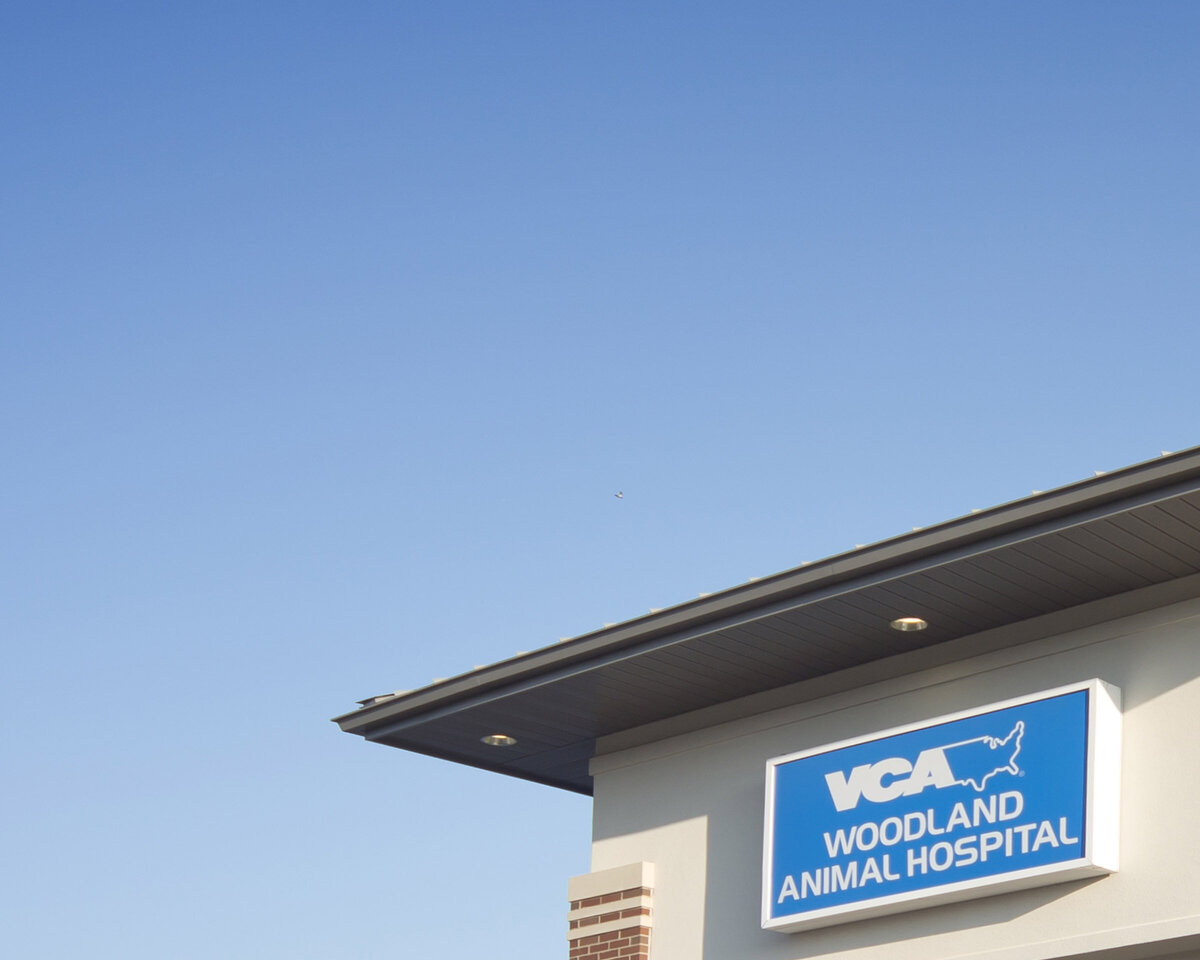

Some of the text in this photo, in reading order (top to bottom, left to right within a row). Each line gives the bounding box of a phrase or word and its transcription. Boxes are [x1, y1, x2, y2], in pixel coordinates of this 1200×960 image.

[824, 749, 957, 812] VCA
[823, 790, 1024, 858] WOODLAND
[777, 817, 1079, 904] ANIMAL HOSPITAL
